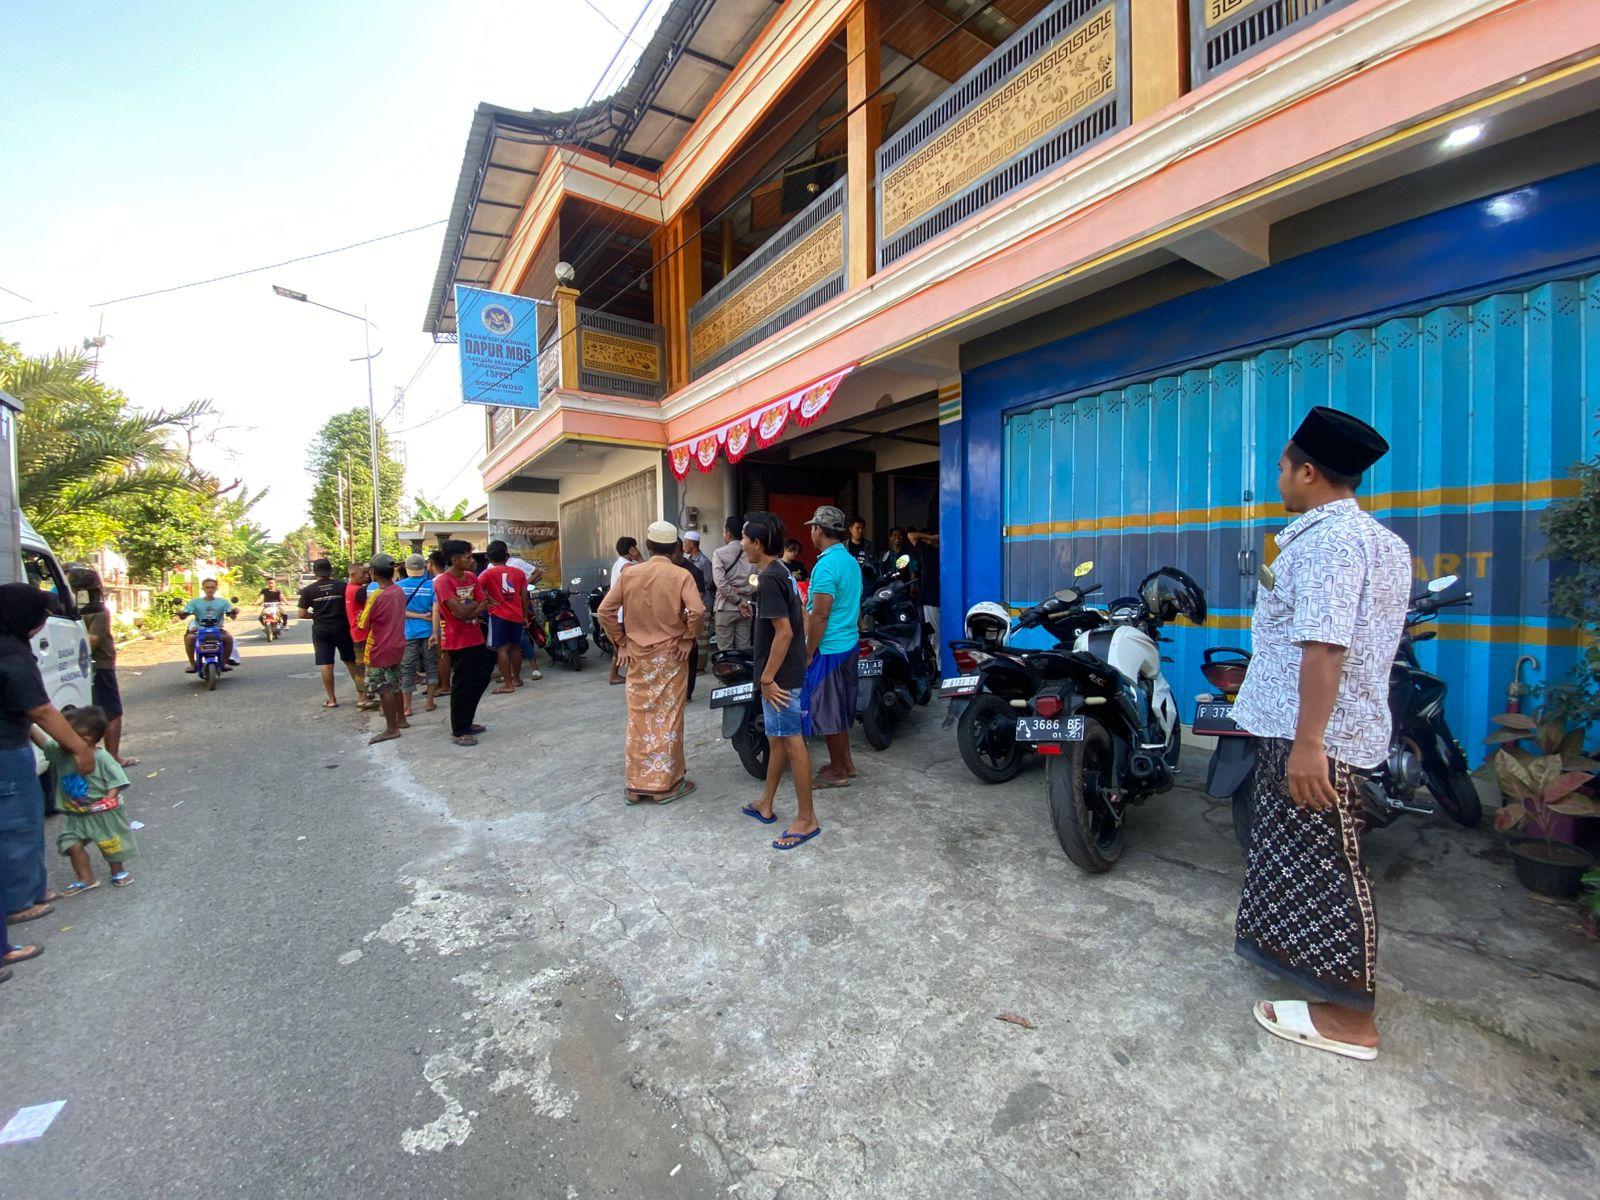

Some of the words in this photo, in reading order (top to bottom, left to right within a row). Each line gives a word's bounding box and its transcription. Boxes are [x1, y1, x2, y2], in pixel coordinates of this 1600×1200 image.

[465, 339, 503, 358] DAPUR
[506, 346, 531, 361] MBG
[475, 380, 523, 391] BONDOWOSO
[507, 526, 554, 536] CHICKEN
[1200, 707, 1207, 718] P
[1033, 719, 1060, 730] 3686
